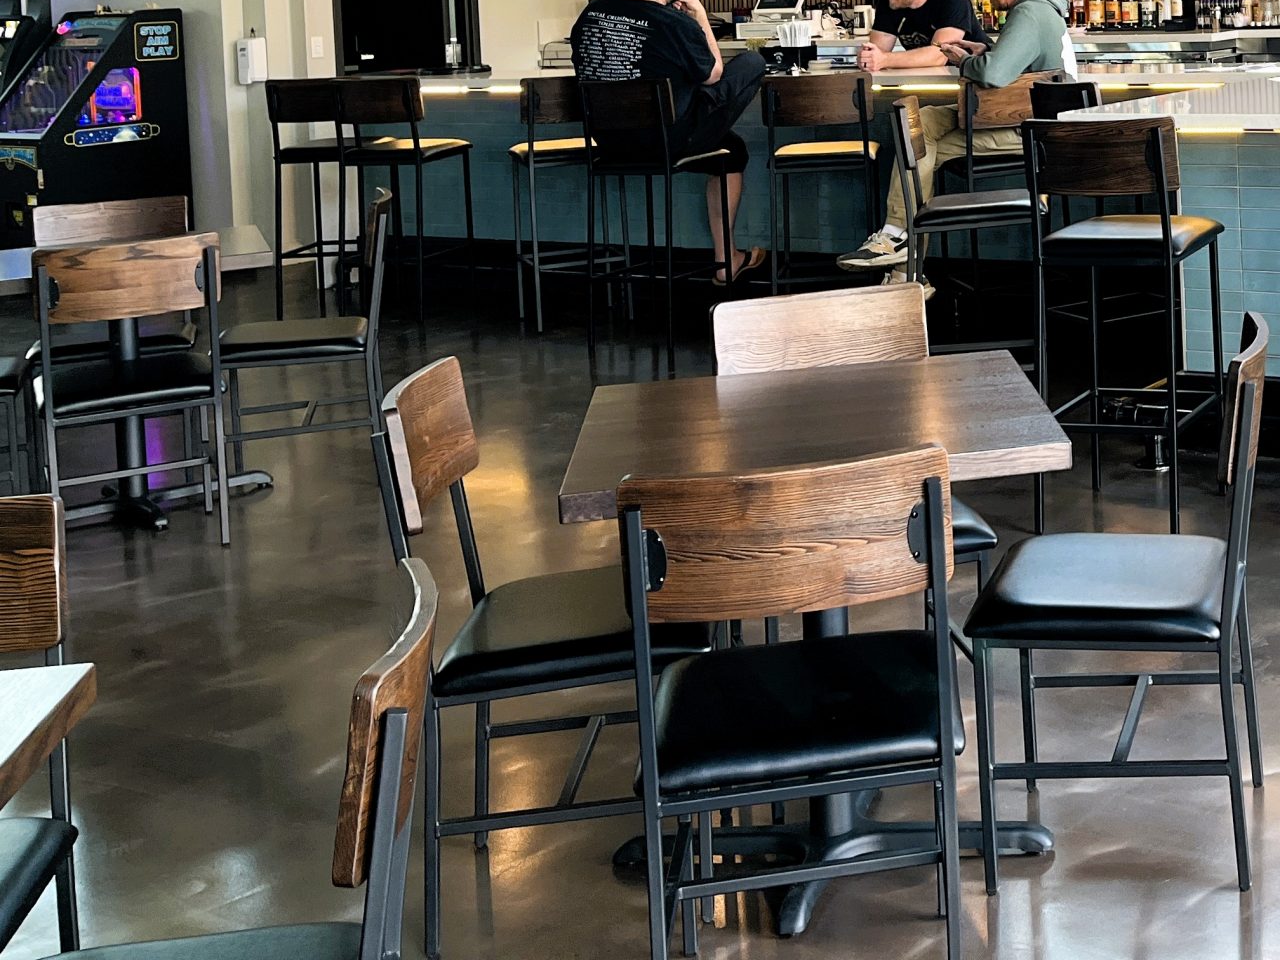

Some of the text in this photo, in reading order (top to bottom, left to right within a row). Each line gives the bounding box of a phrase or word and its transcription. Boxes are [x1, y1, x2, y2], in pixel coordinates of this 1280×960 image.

[140, 25, 171, 36] STOP
[146, 36, 168, 46] AIM
[142, 46, 173, 56] PLAY
